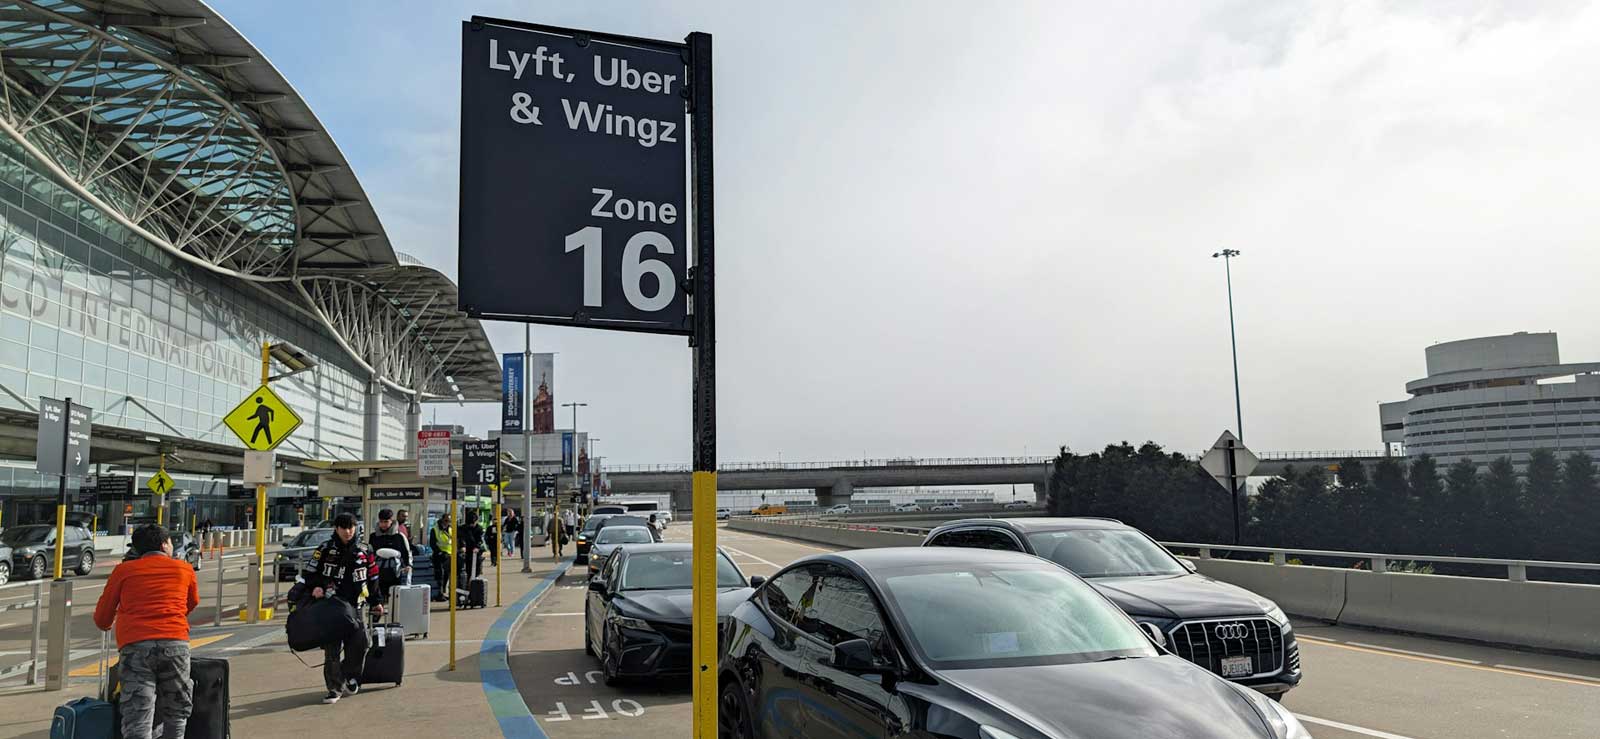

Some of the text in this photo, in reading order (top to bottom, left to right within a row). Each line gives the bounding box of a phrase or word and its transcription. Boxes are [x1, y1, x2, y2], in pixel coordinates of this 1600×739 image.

[489, 39, 677, 95] Lyft, Uber
[509, 91, 677, 148] & Wingz
[591, 187, 677, 224] Zone
[564, 226, 677, 312] 16
[465, 443, 480, 451] Lyft,
[476, 469, 495, 483] 15
[544, 489, 555, 497] 14
[543, 698, 646, 722] OFF
